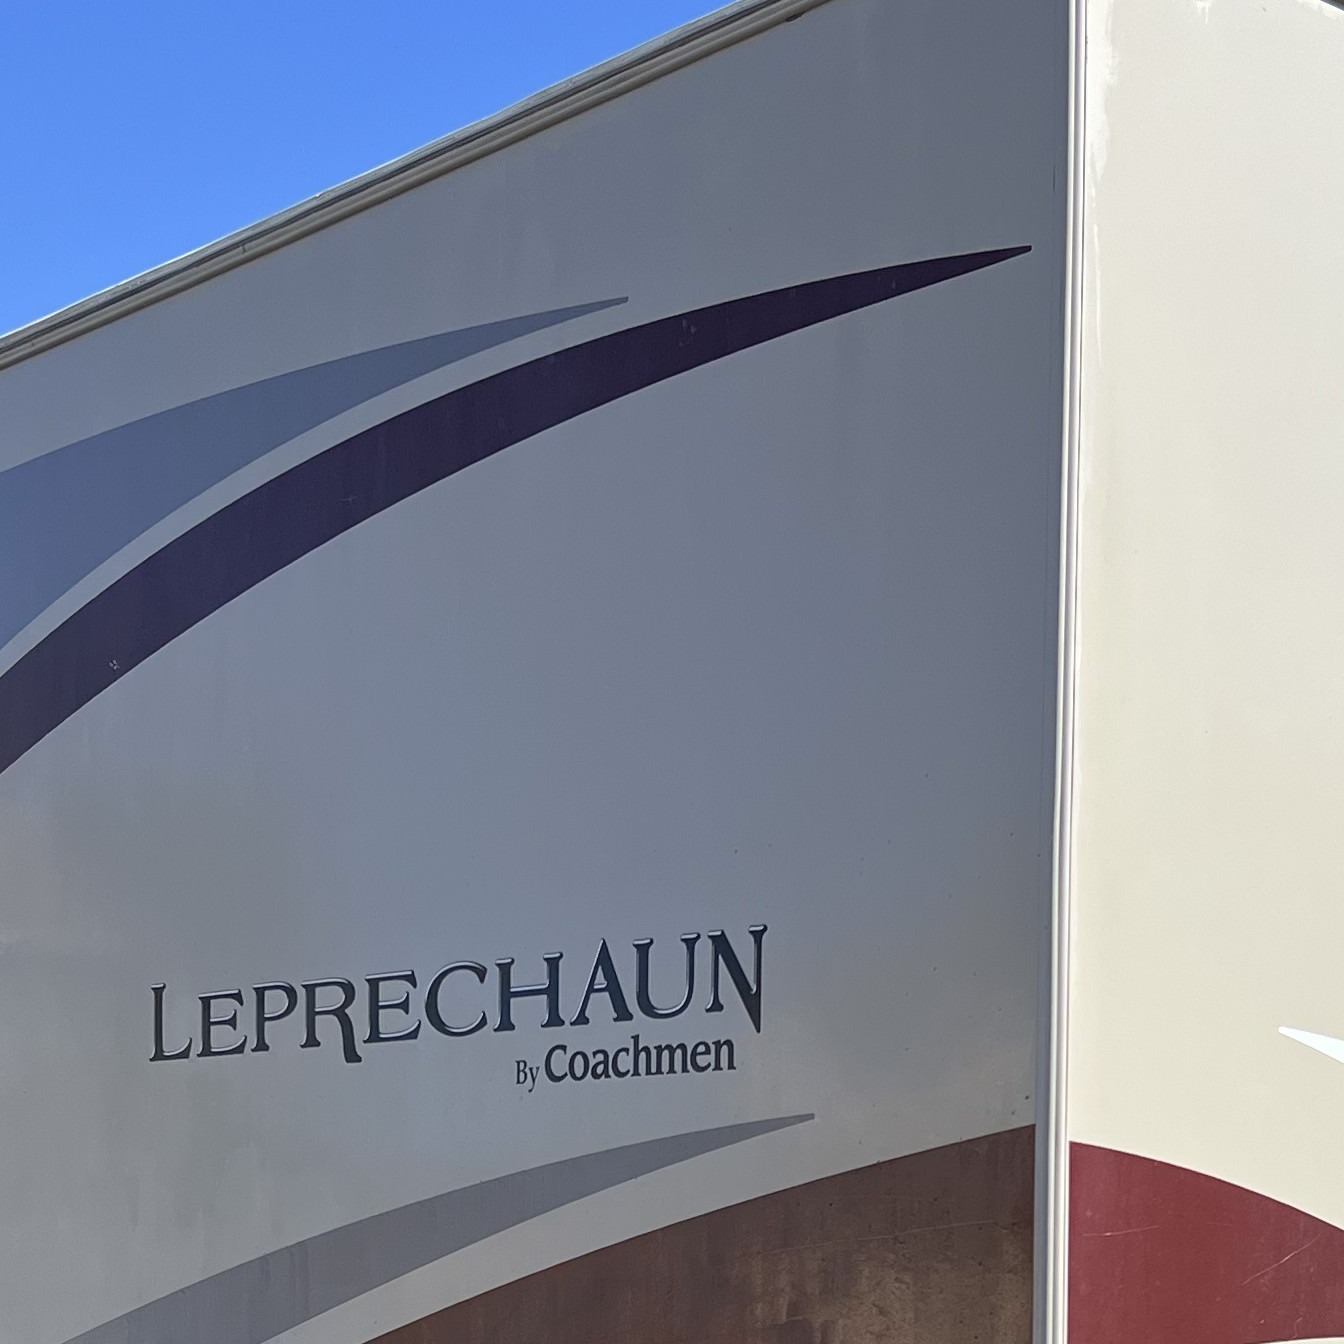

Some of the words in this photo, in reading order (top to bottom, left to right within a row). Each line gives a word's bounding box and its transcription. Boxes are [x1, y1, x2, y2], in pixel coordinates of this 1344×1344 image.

[149, 924, 768, 1063] LEPRECHAUN
[515, 1059, 541, 1093] By
[544, 1034, 737, 1085] Coachmen
